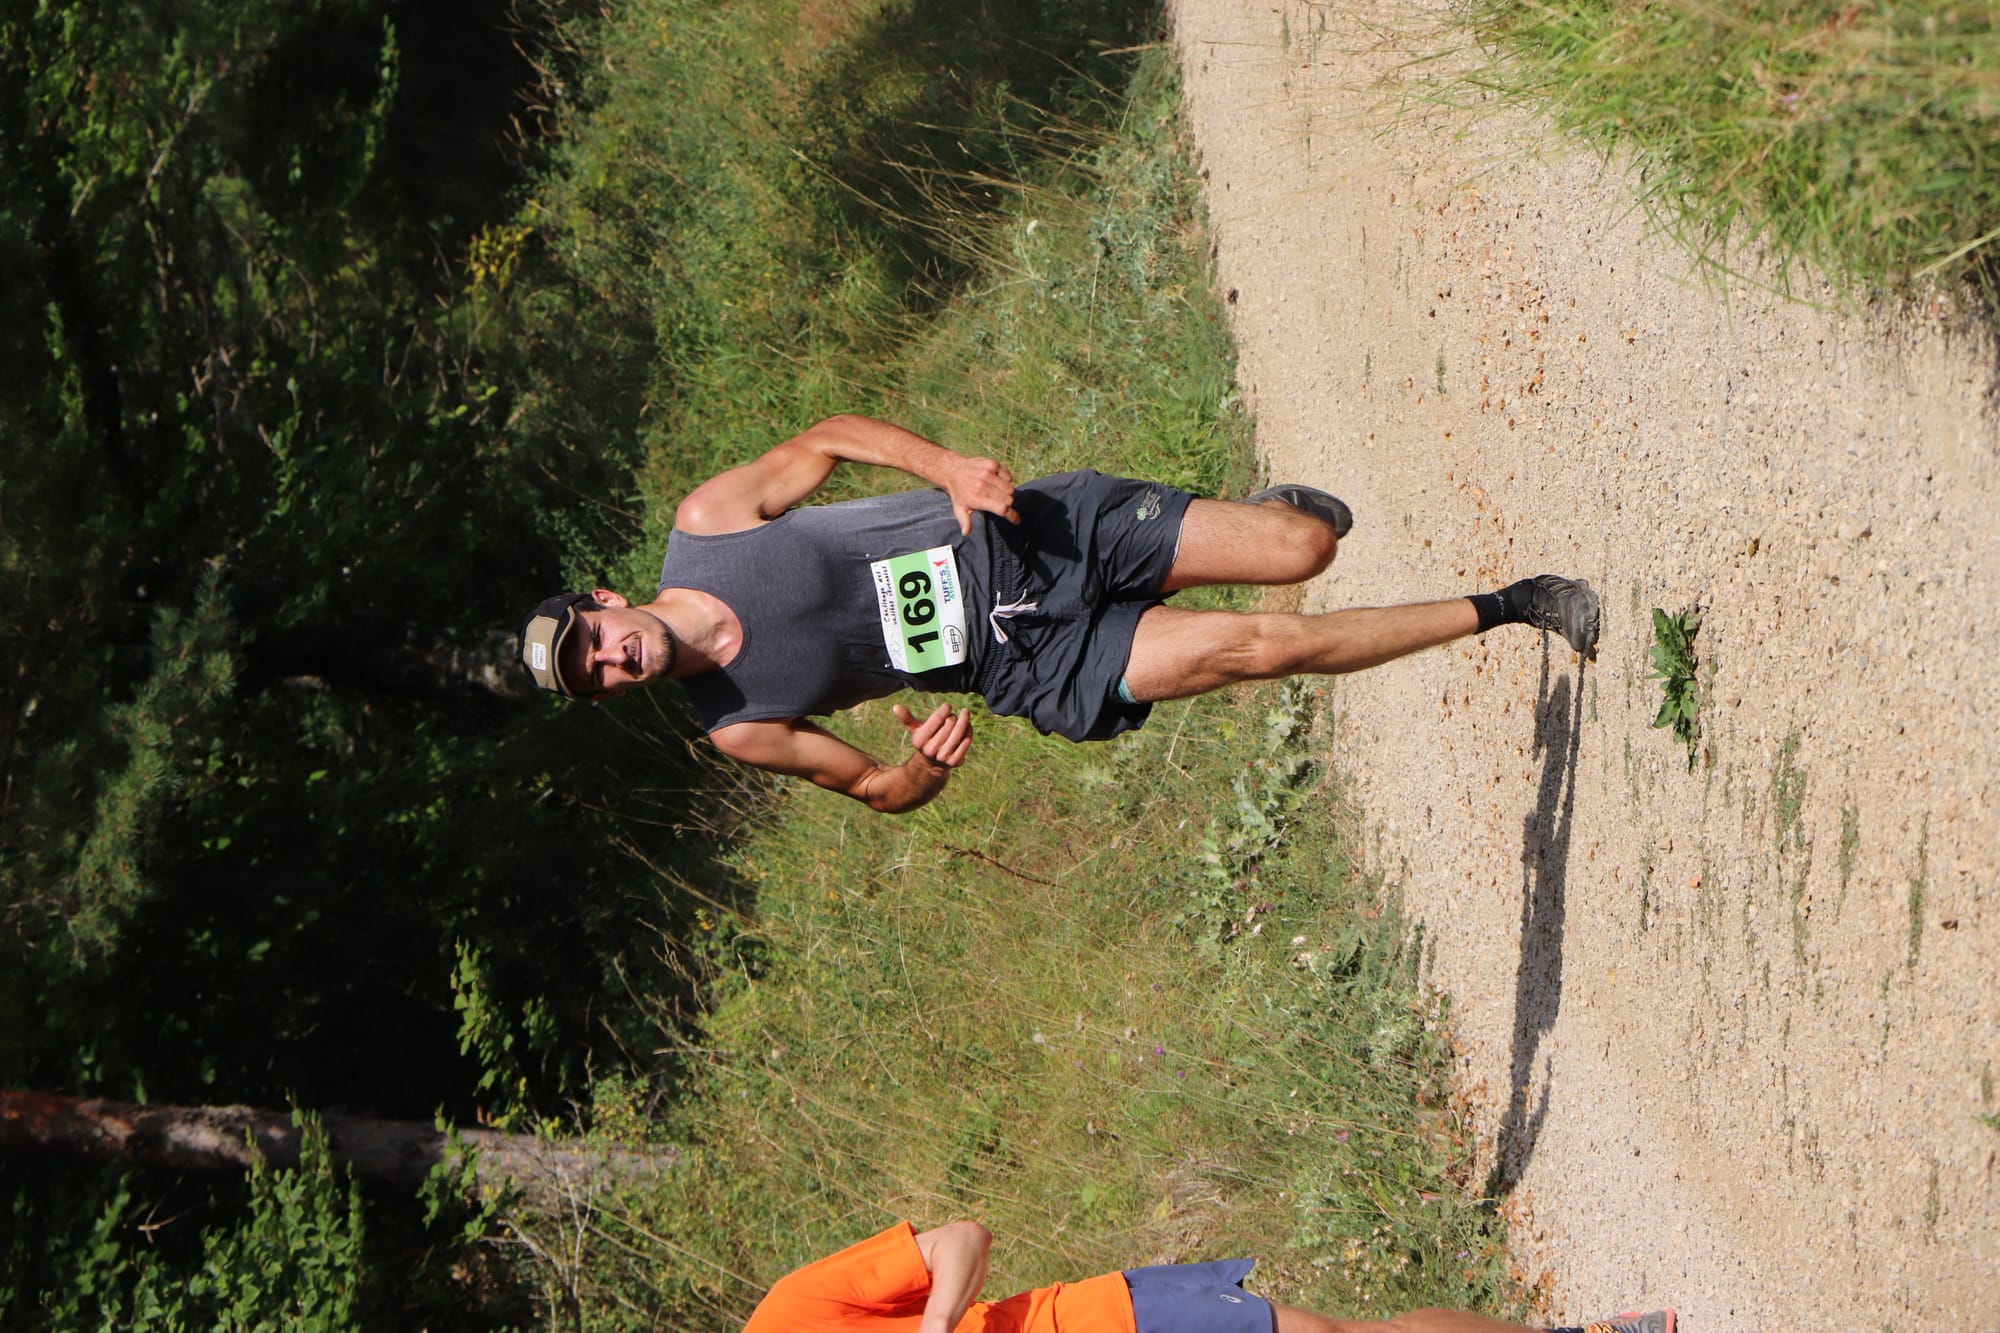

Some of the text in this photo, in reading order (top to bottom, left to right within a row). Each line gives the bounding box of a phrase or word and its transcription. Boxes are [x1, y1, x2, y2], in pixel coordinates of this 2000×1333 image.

[939, 569, 951, 603] TUFF'S
[881, 588, 890, 622] Challenge
[899, 571, 939, 653] 169
